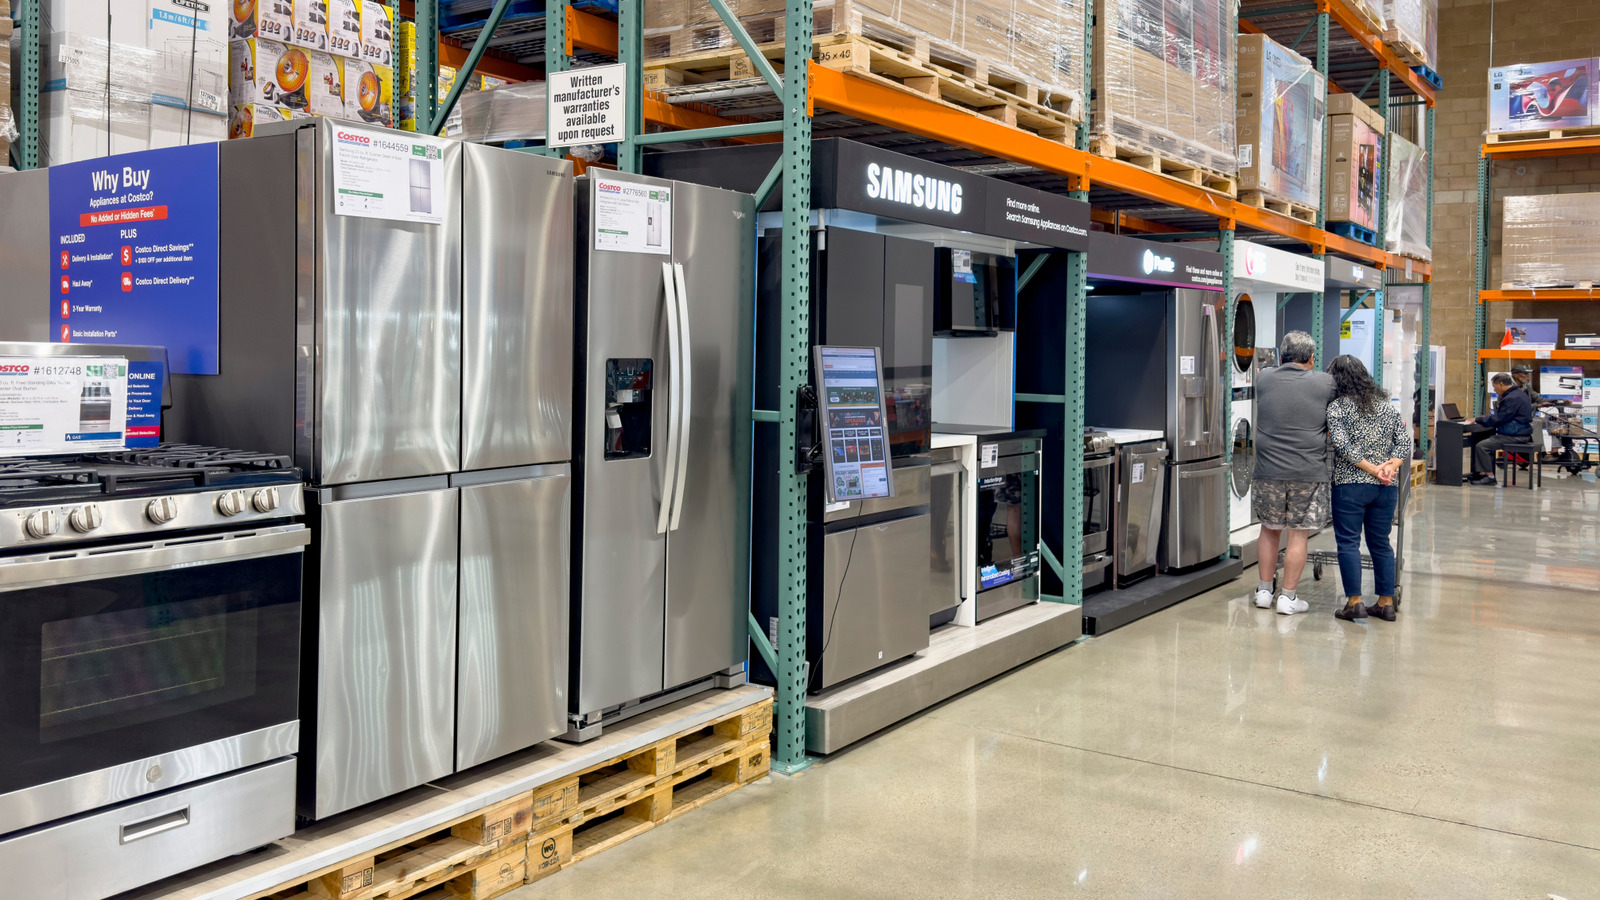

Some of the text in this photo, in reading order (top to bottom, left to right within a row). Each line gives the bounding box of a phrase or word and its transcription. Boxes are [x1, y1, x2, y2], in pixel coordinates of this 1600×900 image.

[570, 75, 602, 88] Written
[554, 85, 620, 103] manufacturer's
[563, 100, 610, 114] warranties
[566, 112, 606, 127] available
[338, 131, 370, 143] COSTCO
[558, 124, 614, 142] upon request
[373, 140, 409, 152] #1644559
[92, 167, 150, 193] Why Buy
[599, 182, 621, 191] COSTCO
[623, 188, 647, 197] #2776560
[867, 162, 963, 214] SAMSUNG
[90, 191, 154, 208] Appliances at Costco?
[1006, 198, 1016, 207] Find
[1016, 201, 1027, 210] more
[91, 215, 97, 223] No
[98, 212, 113, 222] Added
[114, 213, 120, 221] or
[120, 210, 139, 220] Hidden
[1006, 212, 1021, 223] Search
[1022, 215, 1040, 228] Samsung
[1041, 219, 1060, 230] Appliances
[60, 234, 85, 244] INCLUDED
[120, 229, 137, 239] PLUS
[135, 246, 152, 254] Costco
[72, 255, 86, 263] Delivery
[85, 305, 102, 313] Warranty
[34, 366, 81, 375] #1612748
